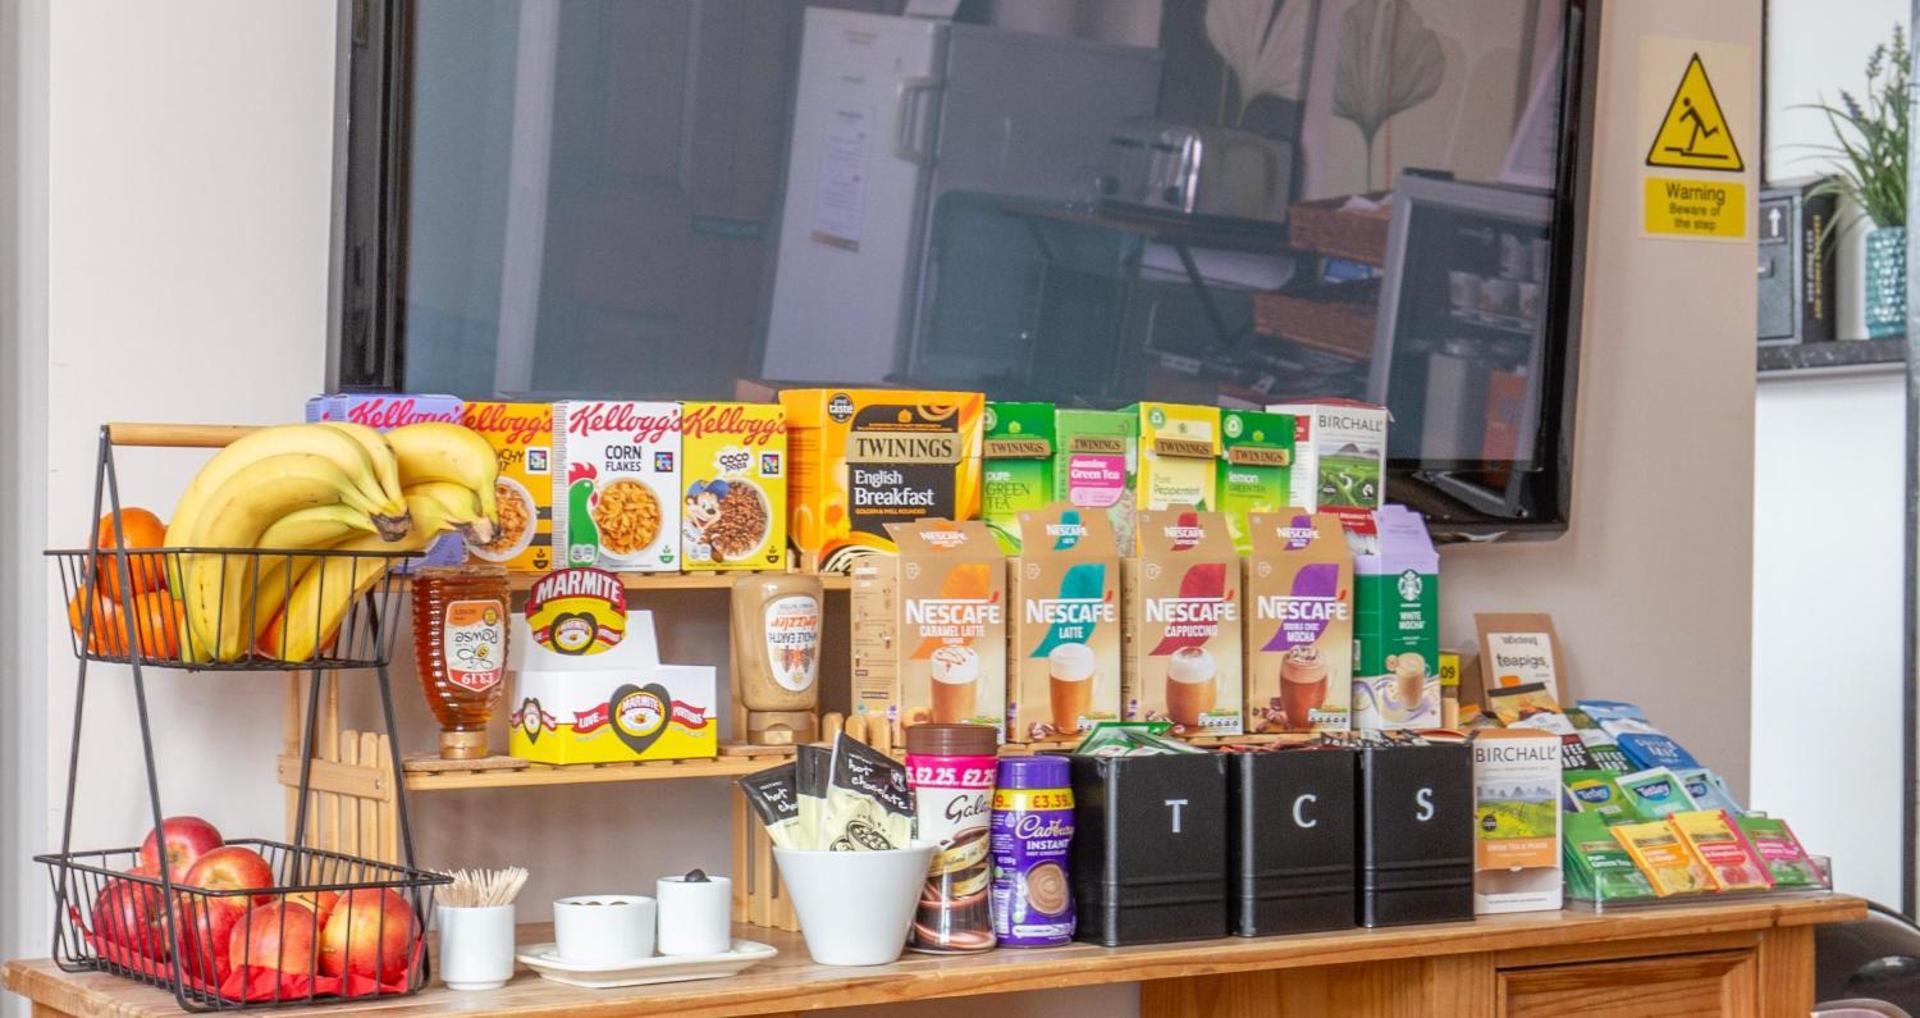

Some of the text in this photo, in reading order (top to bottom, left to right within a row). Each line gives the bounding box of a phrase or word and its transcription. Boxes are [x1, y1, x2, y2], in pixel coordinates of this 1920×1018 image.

[1666, 183, 1725, 205] Warning
[1669, 203, 1721, 216] Beware of
[1674, 218, 1717, 231] the step
[569, 402, 682, 443] Kellogg's
[682, 406, 786, 445] Kellogg's
[1318, 415, 1382, 432] BIRCHALL
[857, 438, 953, 457] TWININGS
[990, 443, 1044, 454] TWININGS
[1075, 439, 1121, 449] TWININGS
[1159, 441, 1210, 455] TWININGS
[605, 446, 641, 460] CORN
[1234, 451, 1284, 463] TWININGS
[606, 461, 641, 472] FLAKES
[855, 469, 903, 487] English
[1071, 469, 1120, 480] Green Tea
[1228, 471, 1259, 482] lemon
[986, 482, 1031, 496] GREEN
[854, 487, 935, 506] Breakfast
[986, 496, 1011, 509] TEA
[536, 570, 620, 603] MARMITE
[455, 629, 498, 643] Rowse
[1059, 626, 1083, 639] LATTE
[461, 673, 494, 685] £3.19
[1475, 746, 1556, 763] BIRCHALL
[848, 759, 873, 776] hot
[763, 789, 788, 801] hot
[851, 776, 908, 810] chocolate
[1293, 794, 1317, 828] C
[1416, 788, 1434, 822] S
[1165, 799, 1188, 833] T
[1016, 815, 1075, 841] Cadbury
[1027, 839, 1070, 850] INSTANT
